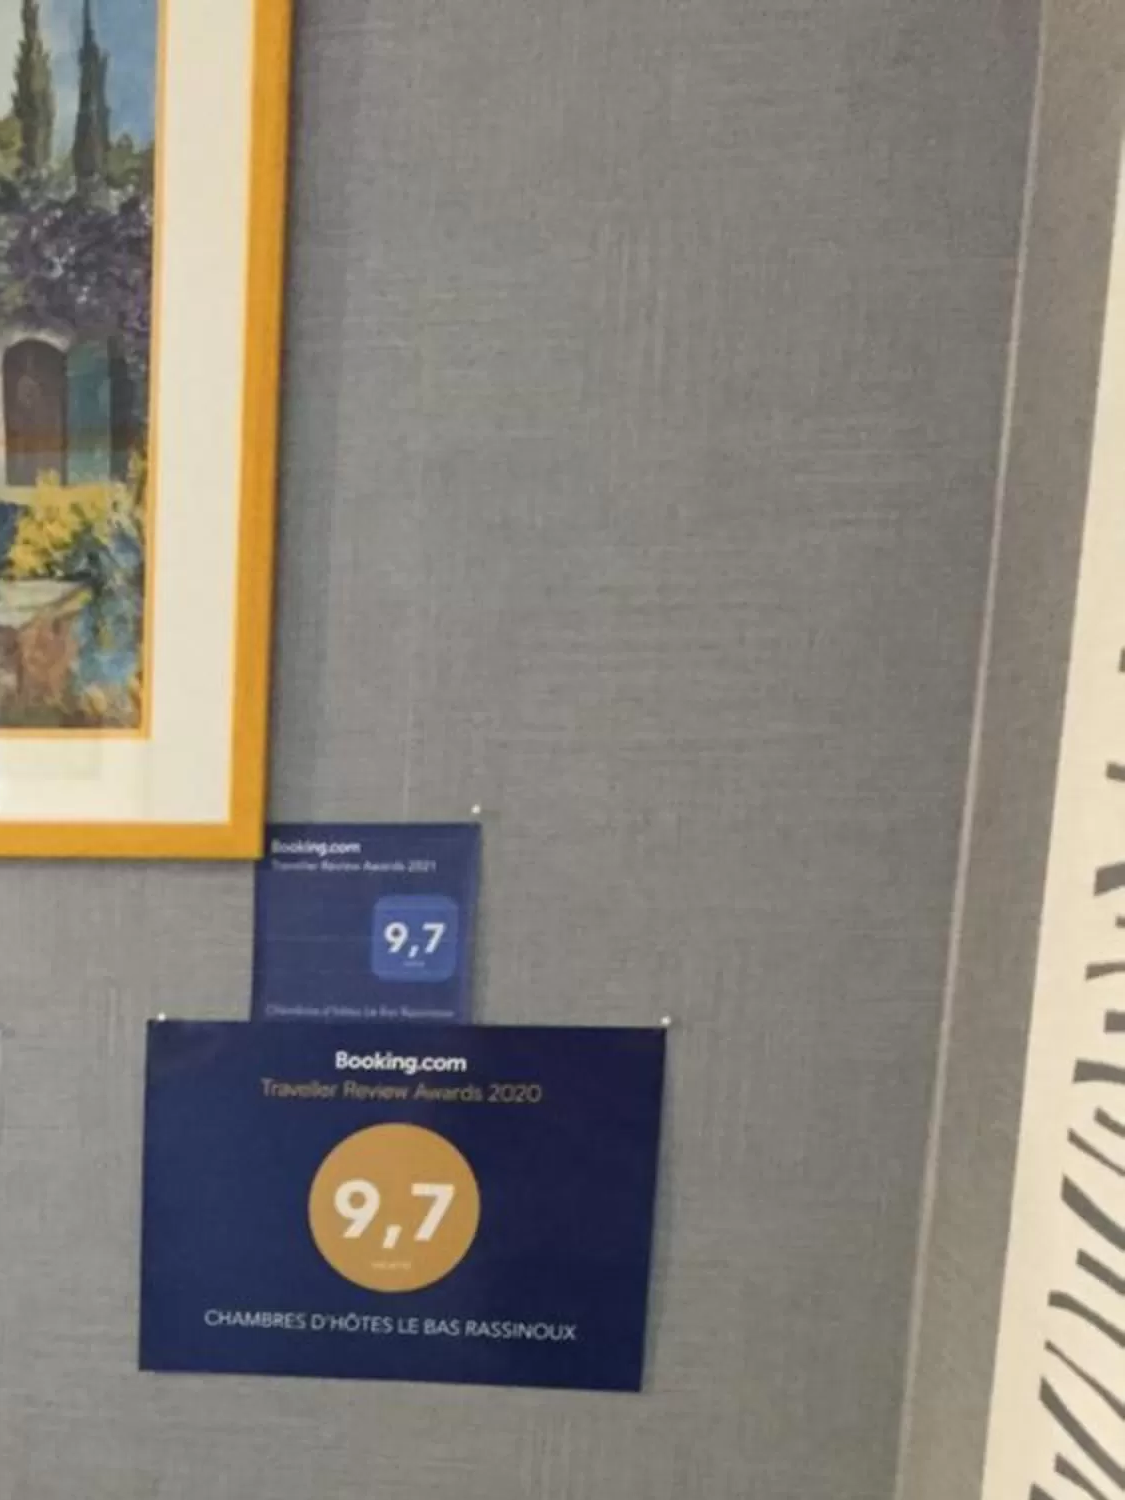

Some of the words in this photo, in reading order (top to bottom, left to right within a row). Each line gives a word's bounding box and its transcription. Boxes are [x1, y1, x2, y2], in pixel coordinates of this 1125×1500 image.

[383, 921, 446, 958] 9,7
[335, 1051, 467, 1075] Booking.com
[261, 1077, 337, 1098] Traveller
[342, 1079, 410, 1100] Review
[413, 1082, 482, 1102] Awards
[486, 1083, 543, 1104] 2020
[333, 1178, 456, 1250] 9,7
[204, 1308, 307, 1331] CHAMBRES
[310, 1311, 394, 1335] D'HÔTES
[397, 1315, 422, 1336] LE
[424, 1317, 461, 1338] BAS
[464, 1320, 578, 1341] RASSINOUX
